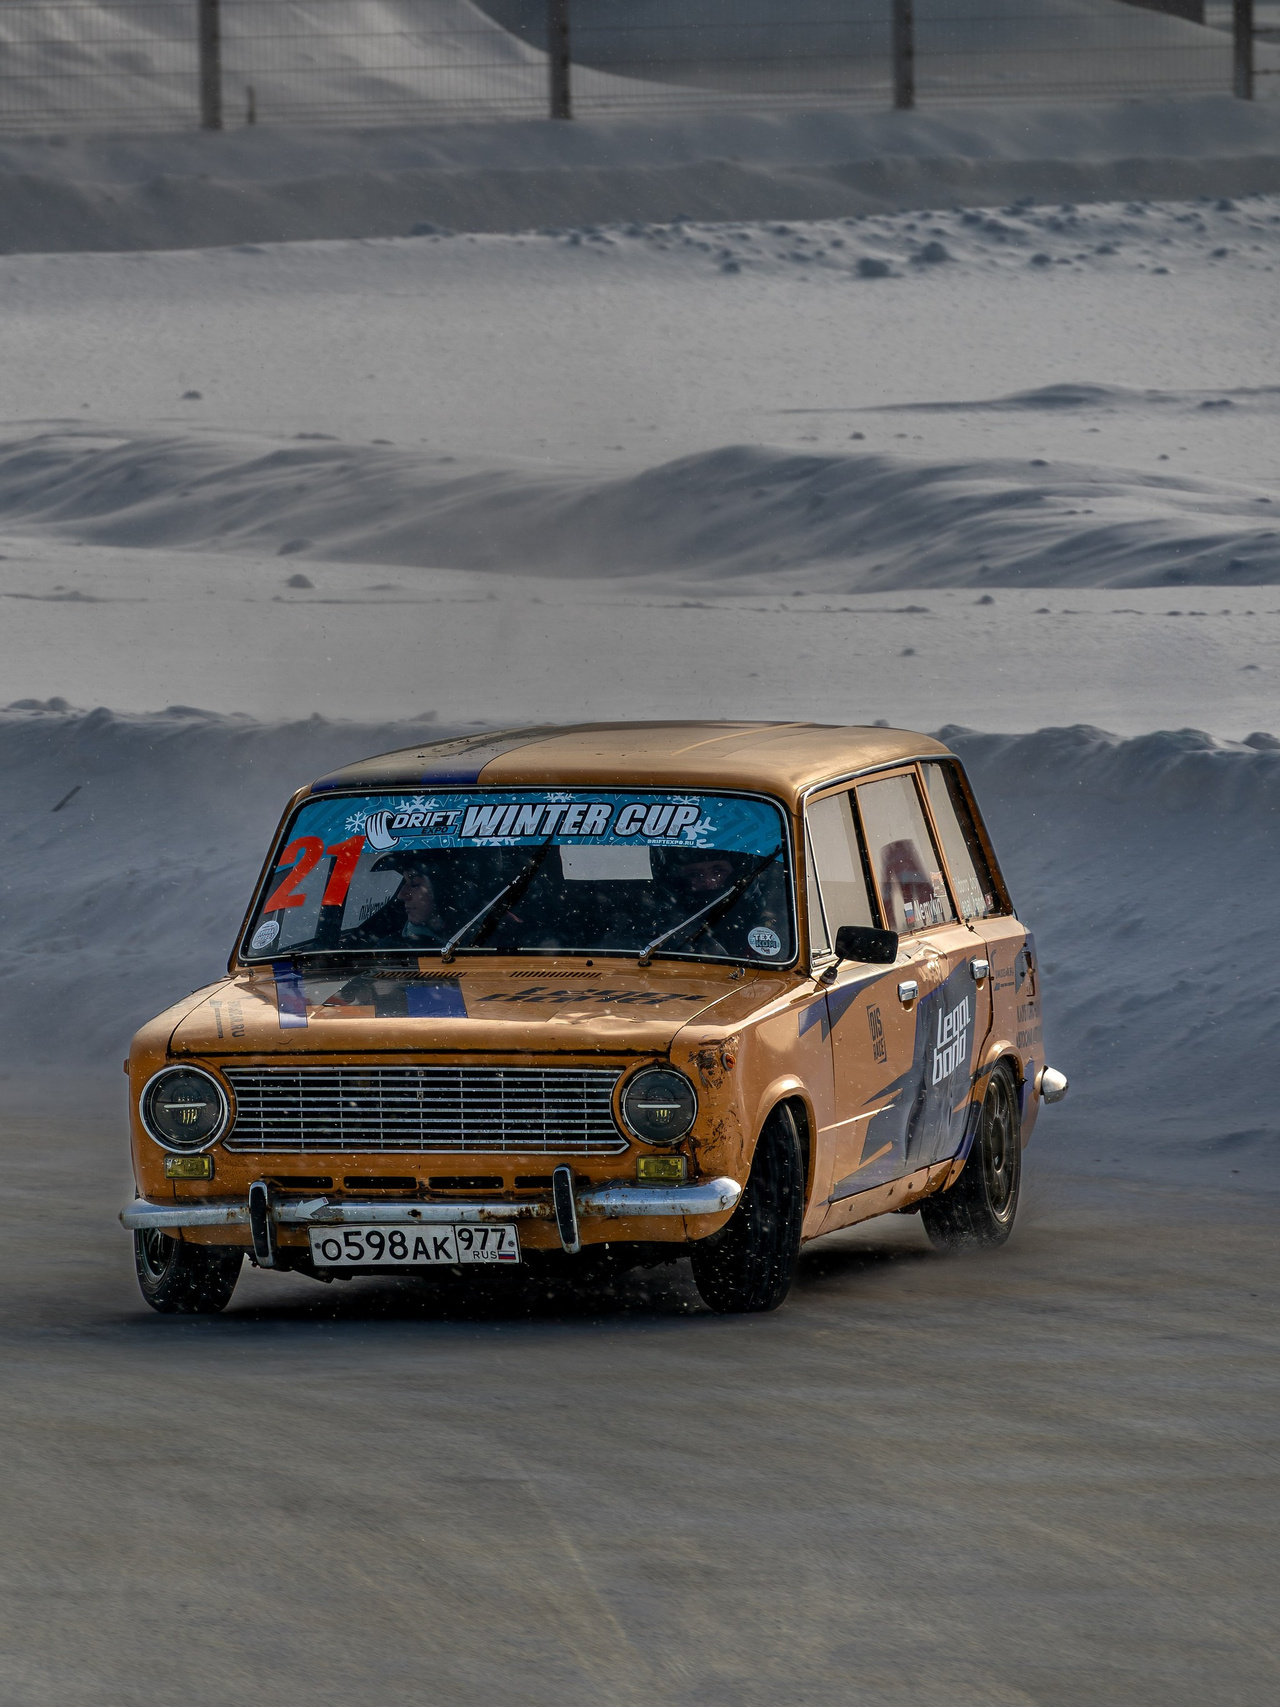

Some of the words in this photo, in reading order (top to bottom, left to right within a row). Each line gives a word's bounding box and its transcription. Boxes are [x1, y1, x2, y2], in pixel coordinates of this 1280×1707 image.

[391, 810, 462, 828] DRIFT
[460, 802, 614, 838] WINTER
[614, 802, 701, 837] CUP
[420, 826, 449, 835] EXPO
[646, 838, 695, 846] DRIFTEXPO.RU
[263, 835, 367, 914] 21
[457, 1228, 506, 1250] 977
[473, 1250, 498, 1260] RUS
